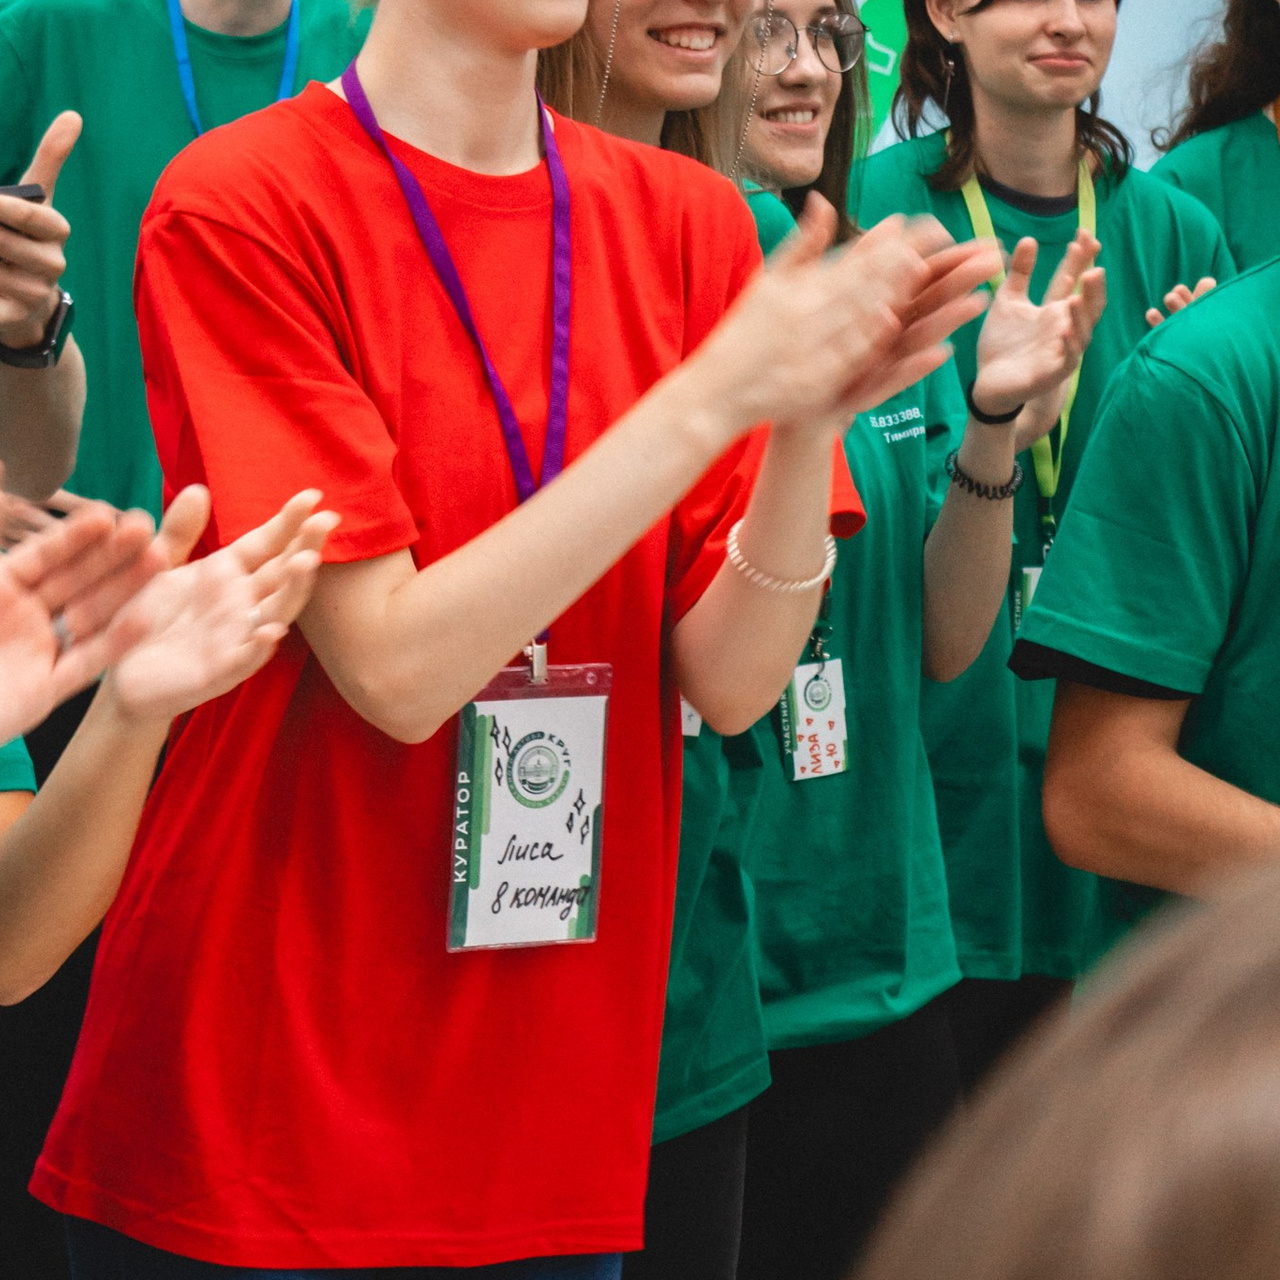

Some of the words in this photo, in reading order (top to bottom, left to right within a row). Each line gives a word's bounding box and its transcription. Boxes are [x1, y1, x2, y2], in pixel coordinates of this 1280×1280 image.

[548, 733, 571, 767] КРУГ
[453, 771, 471, 883] КУРАТОР
[497, 833, 564, 865] Лиса
[491, 881, 509, 914] 8
